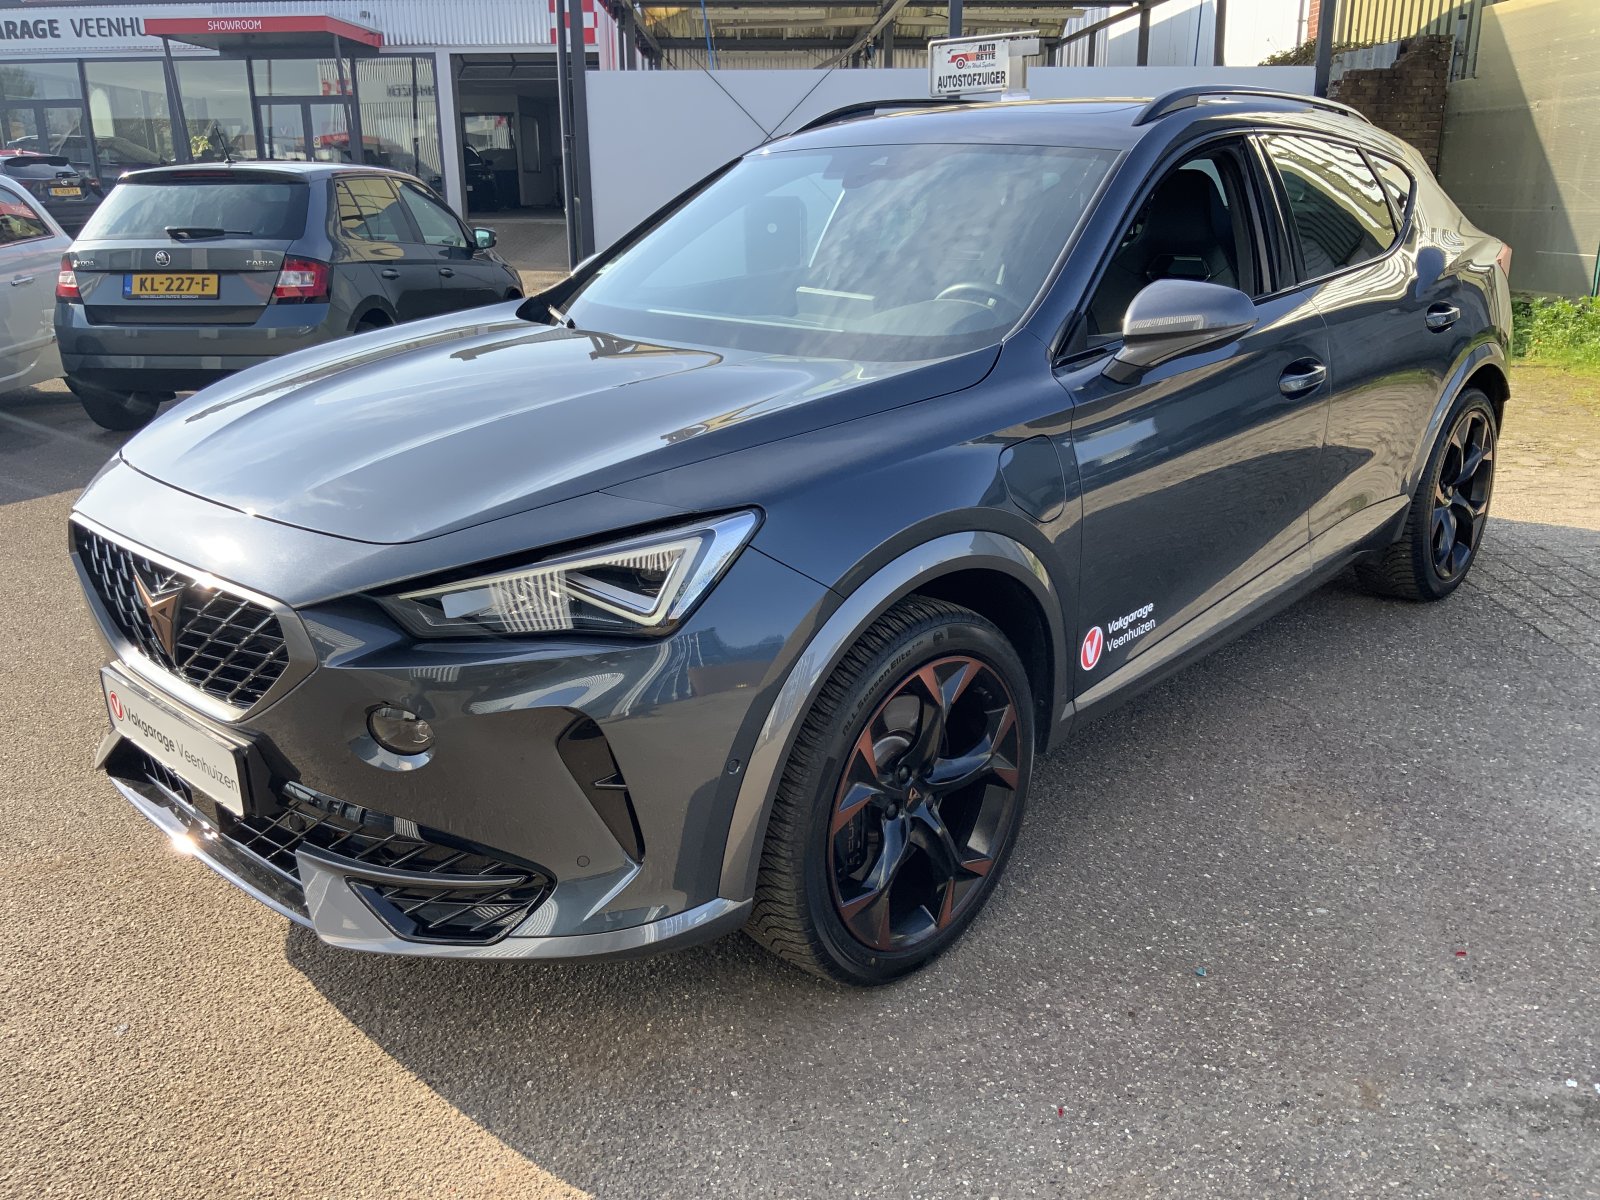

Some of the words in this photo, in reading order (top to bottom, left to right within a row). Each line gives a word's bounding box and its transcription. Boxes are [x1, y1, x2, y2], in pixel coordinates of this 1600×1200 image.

[207, 20, 262, 31] SHOWROOM
[978, 43, 996, 52] AUTO
[976, 52, 996, 61] RETTE
[937, 70, 1006, 89] AUTOSTOFZUIGER
[139, 277, 210, 292] KL-227-F
[1107, 602, 1154, 634] Vakgarage
[1106, 619, 1156, 652] Veenhuizen
[124, 704, 175, 753] Vakgarage
[176, 739, 239, 794] Veenhuizen
